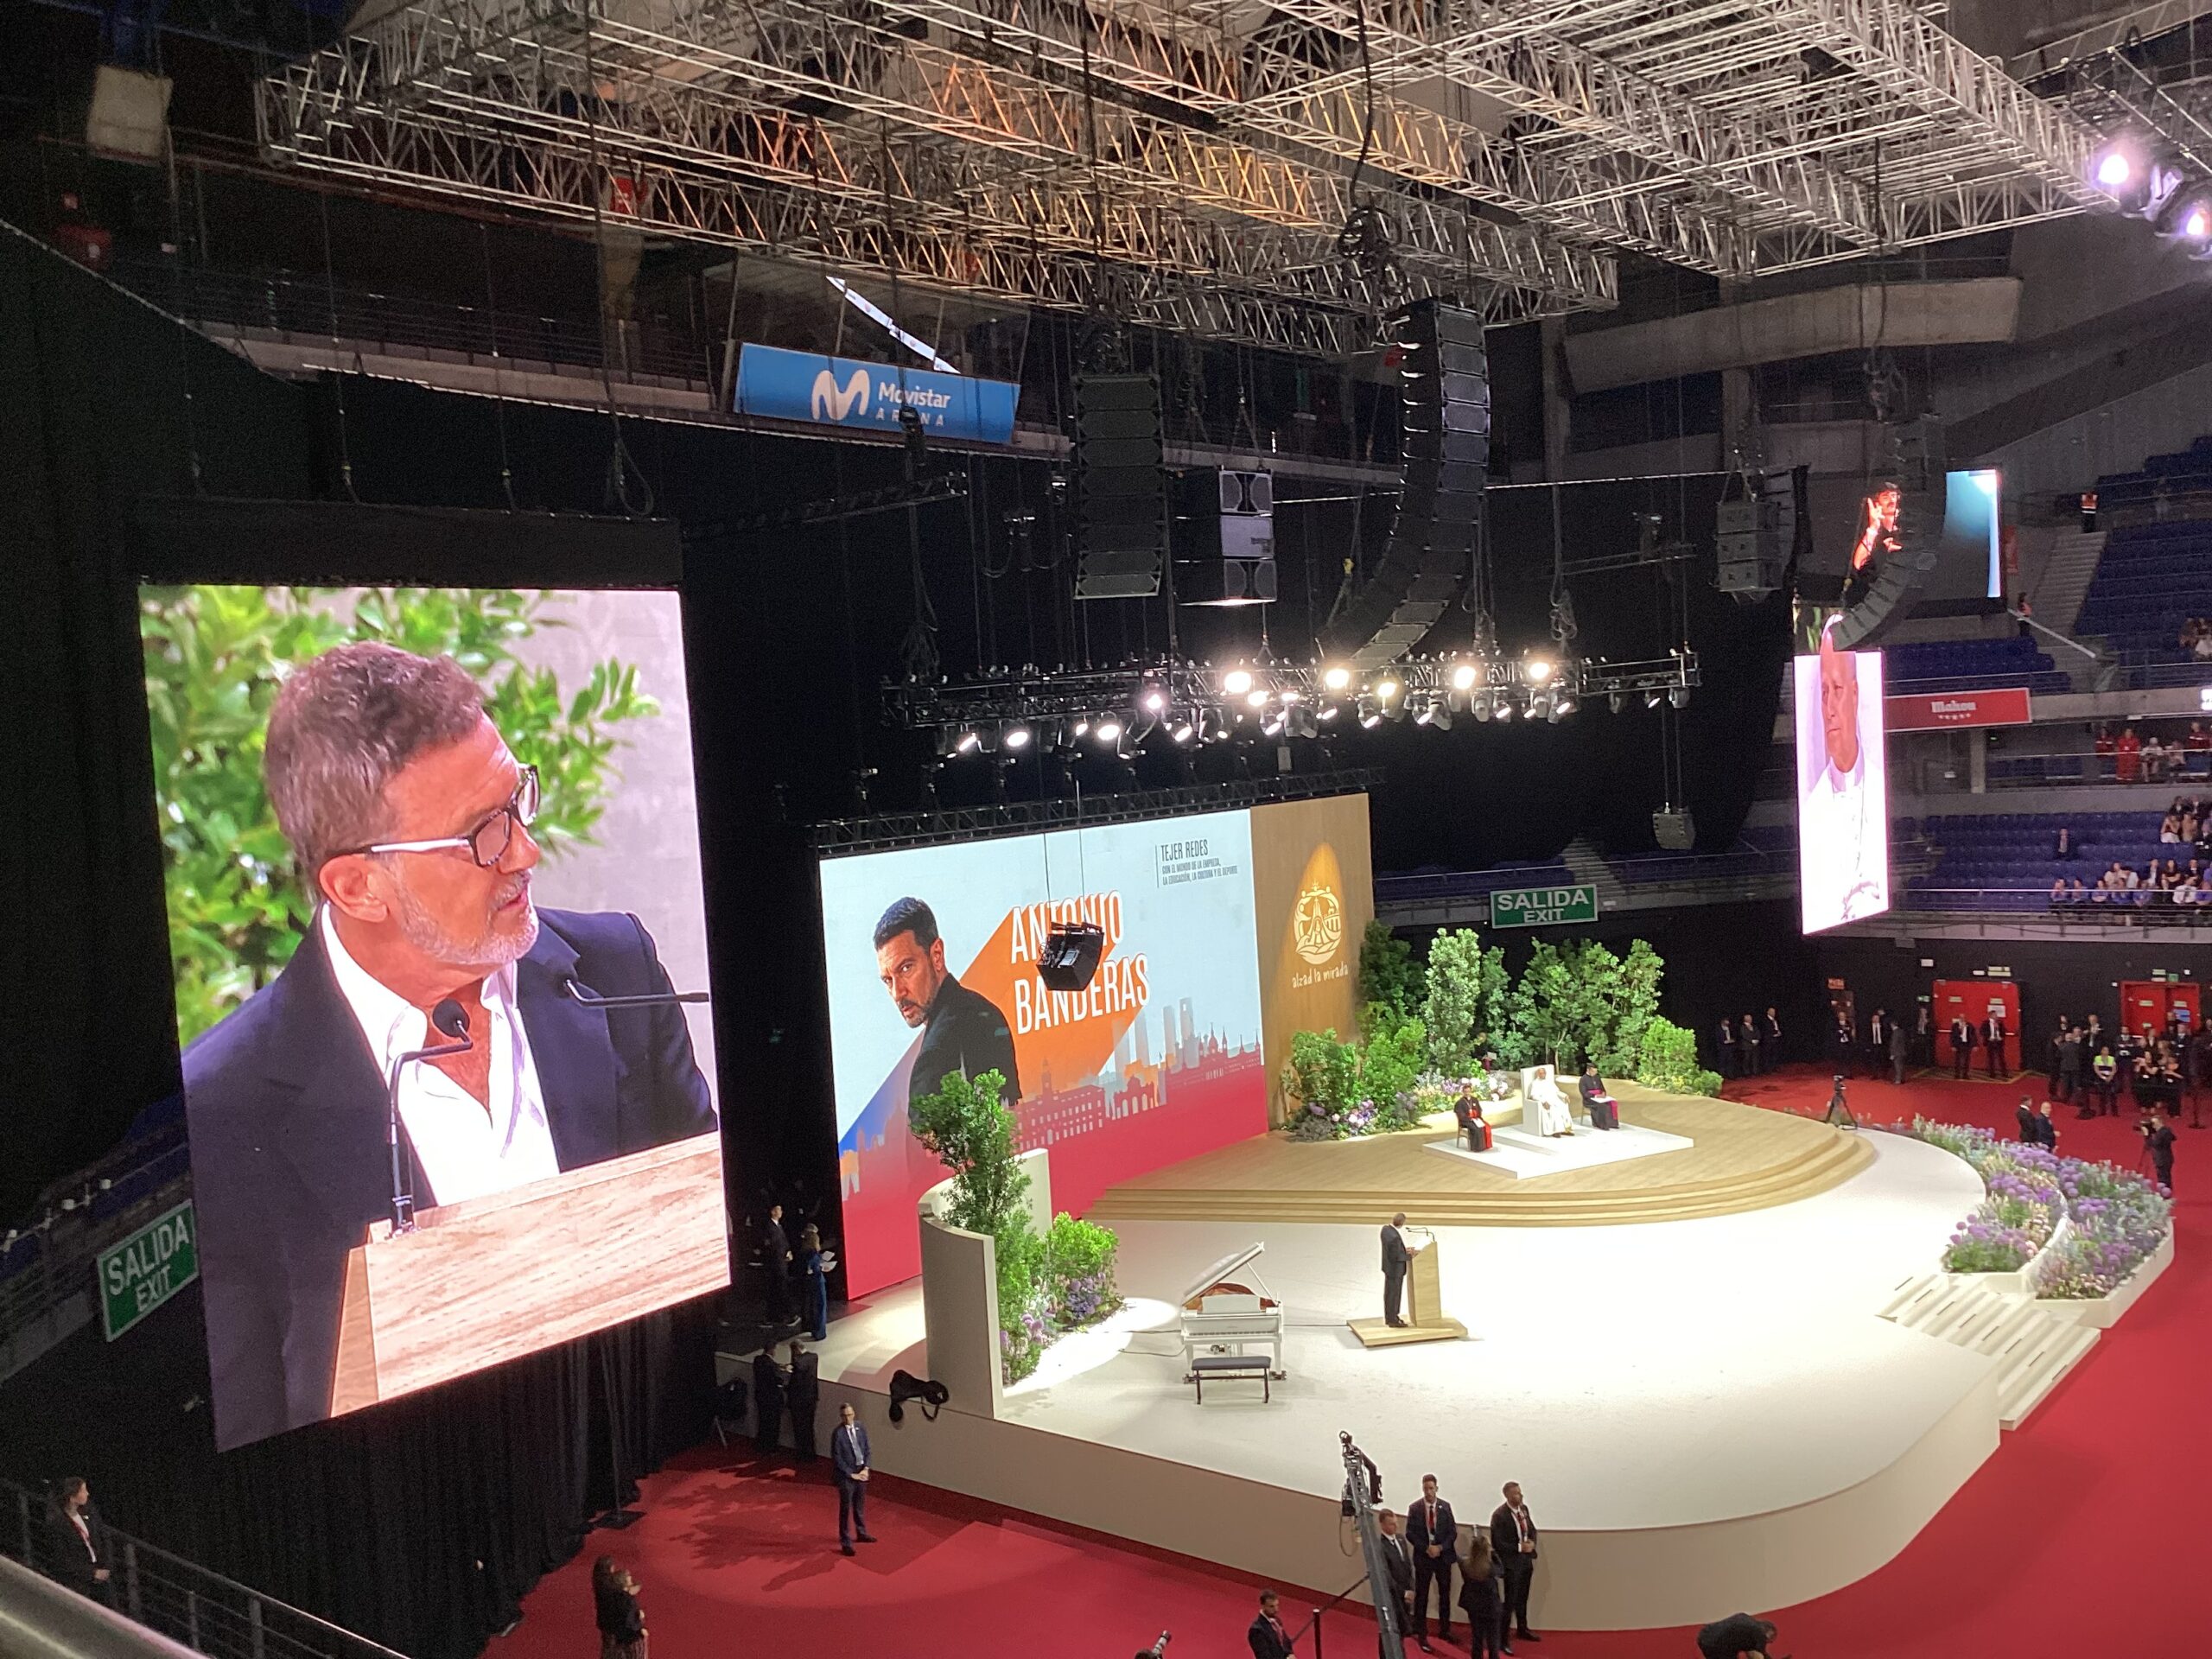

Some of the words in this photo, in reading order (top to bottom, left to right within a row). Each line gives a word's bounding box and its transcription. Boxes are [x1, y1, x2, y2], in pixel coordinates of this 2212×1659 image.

[878, 382, 951, 408] Movistar
[875, 407, 944, 426] ARNA
[1160, 842, 1183, 861] TEJER
[1185, 839, 1208, 858] REDES
[1497, 889, 1589, 911] SALIDA
[1523, 908, 1564, 923] EXIT
[1292, 968, 1313, 988] alzad
[1313, 968, 1321, 982] la
[1323, 961, 1348, 981] mirada
[1014, 953, 1151, 1035] BANDERAS
[107, 1215, 189, 1295] SALIDA
[136, 1264, 171, 1312] EXIT
